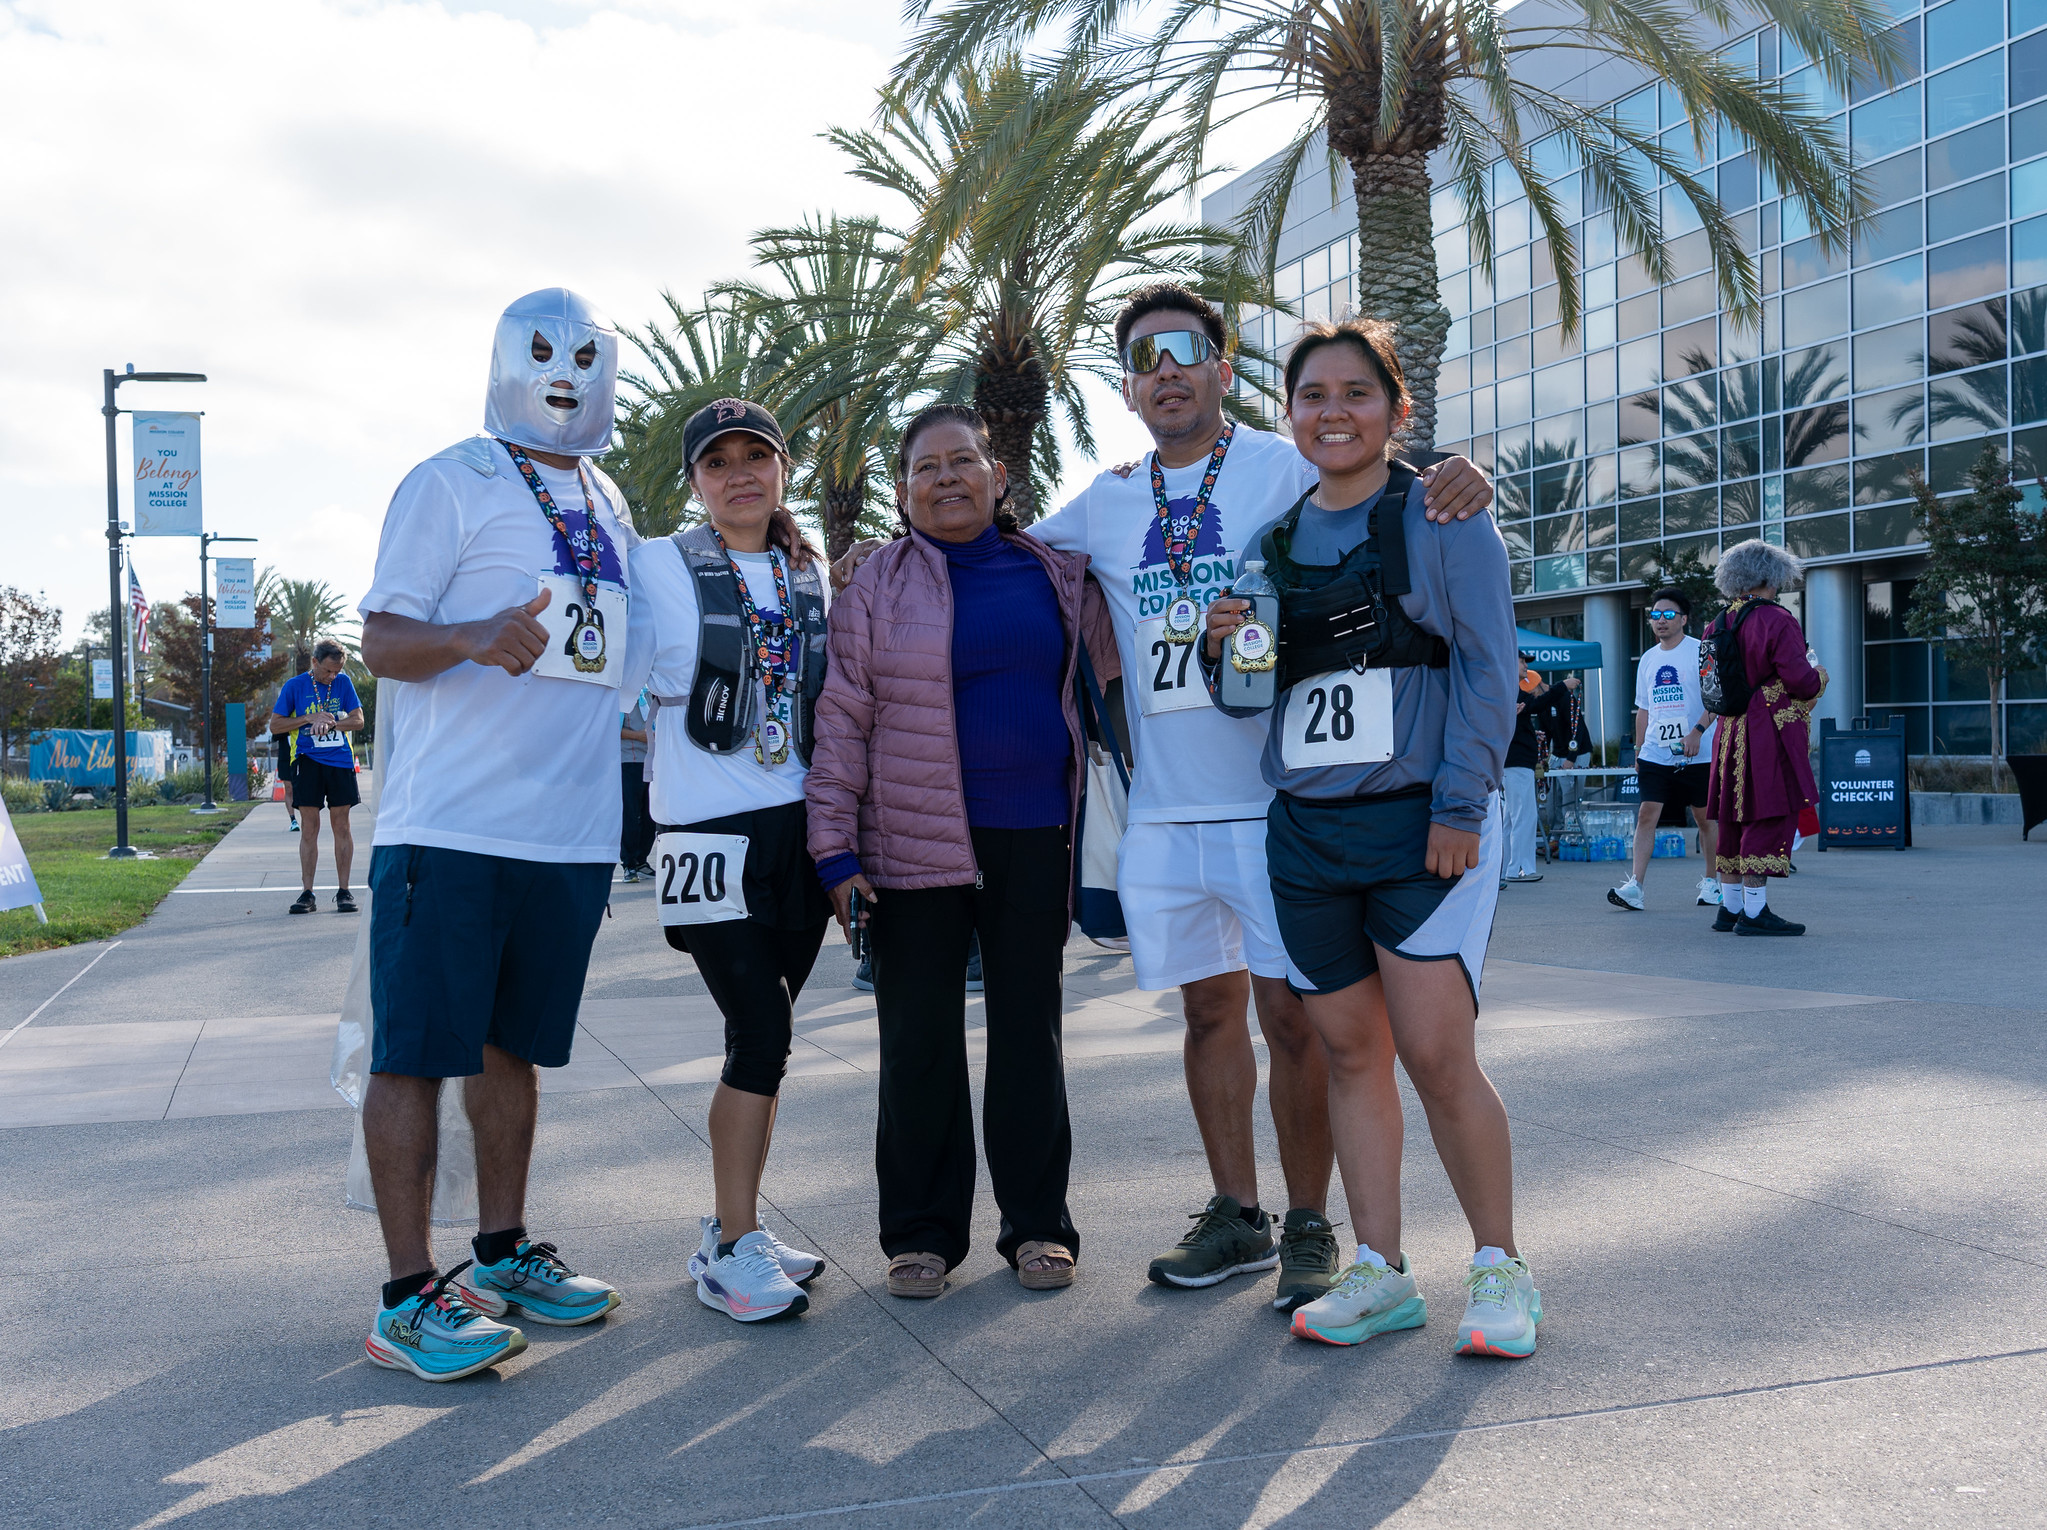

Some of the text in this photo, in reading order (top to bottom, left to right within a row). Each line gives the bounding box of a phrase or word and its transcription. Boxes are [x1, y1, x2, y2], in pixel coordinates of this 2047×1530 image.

[157, 449, 178, 457] YOU
[136, 457, 199, 490] Belong
[148, 490, 188, 498] MISSION
[149, 499, 188, 507] COLLEGE
[1133, 559, 1235, 595] MISON
[218, 583, 251, 594] Welcome
[1151, 640, 1195, 693] 27
[1652, 686, 1683, 696] MISSION
[1653, 694, 1684, 704] COLLEGE
[716, 684, 730, 722] AONIJIE
[1304, 683, 1355, 744] 28
[1659, 722, 1685, 741] 221
[48, 738, 139, 783] New Librry
[1830, 780, 1895, 790] VOLUNTEER
[1831, 791, 1894, 802] CHECK-IN
[661, 852, 726, 905] 220
[388, 1317, 424, 1349] HOKA
